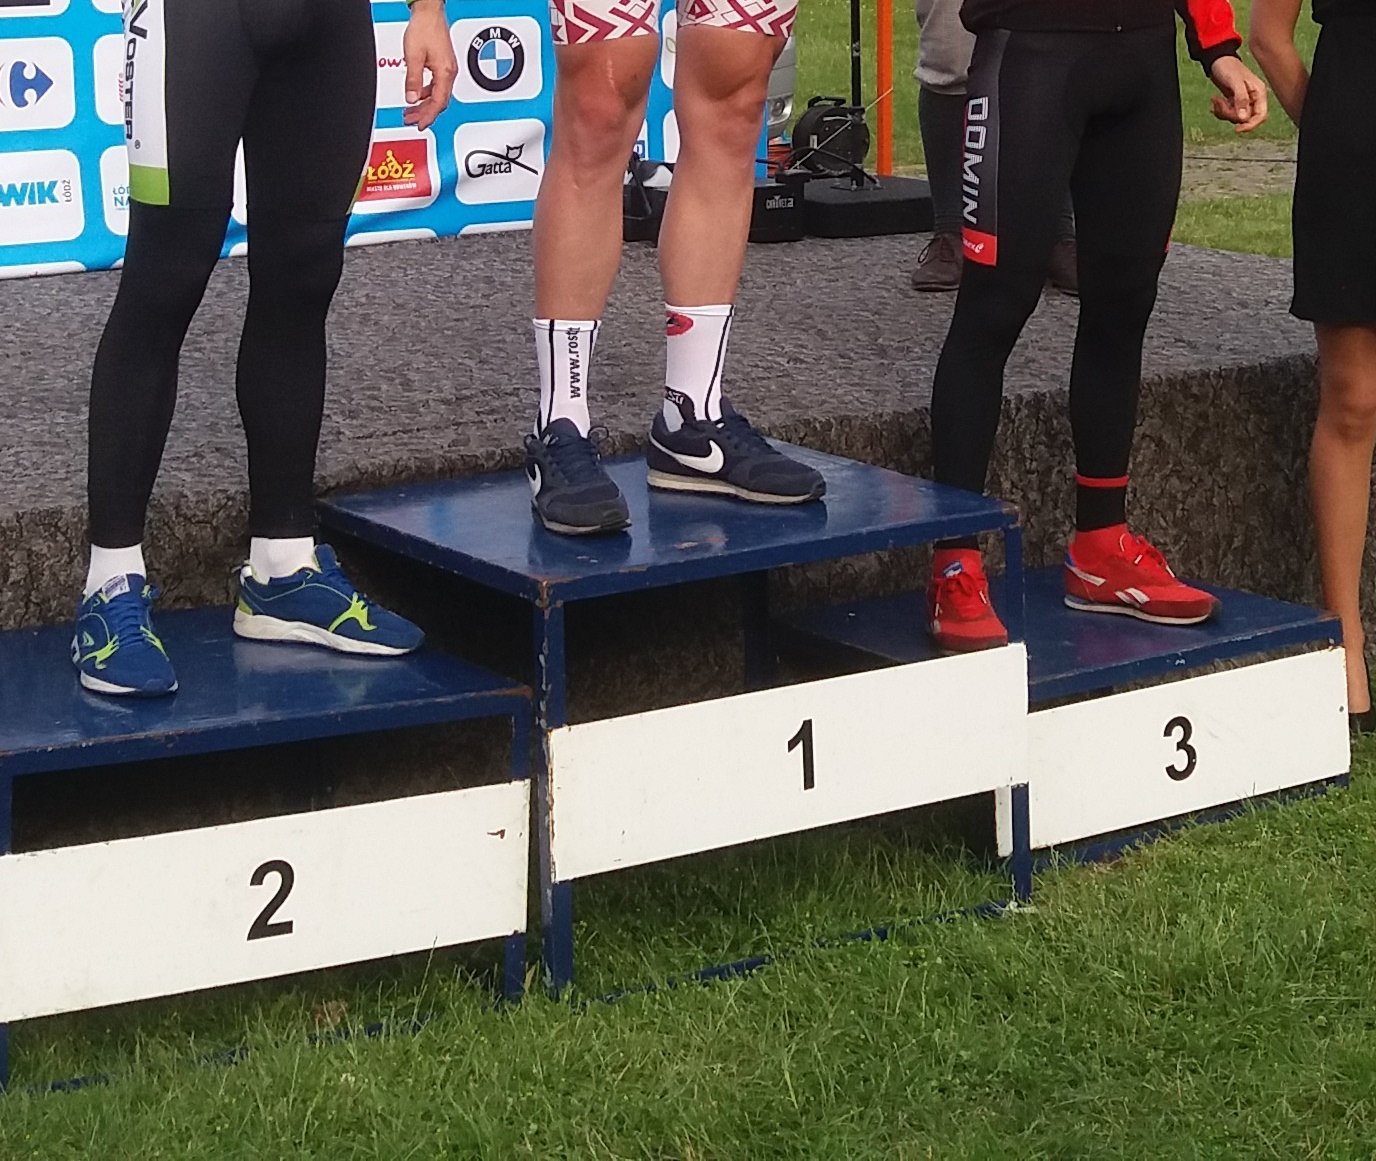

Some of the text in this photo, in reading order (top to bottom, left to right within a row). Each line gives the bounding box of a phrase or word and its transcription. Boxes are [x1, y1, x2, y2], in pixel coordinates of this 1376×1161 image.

[471, 27, 522, 50] BMW
[962, 96, 989, 225] DOMIN
[786, 718, 815, 791] 1
[1163, 716, 1198, 782] 3
[246, 859, 296, 942] 2
